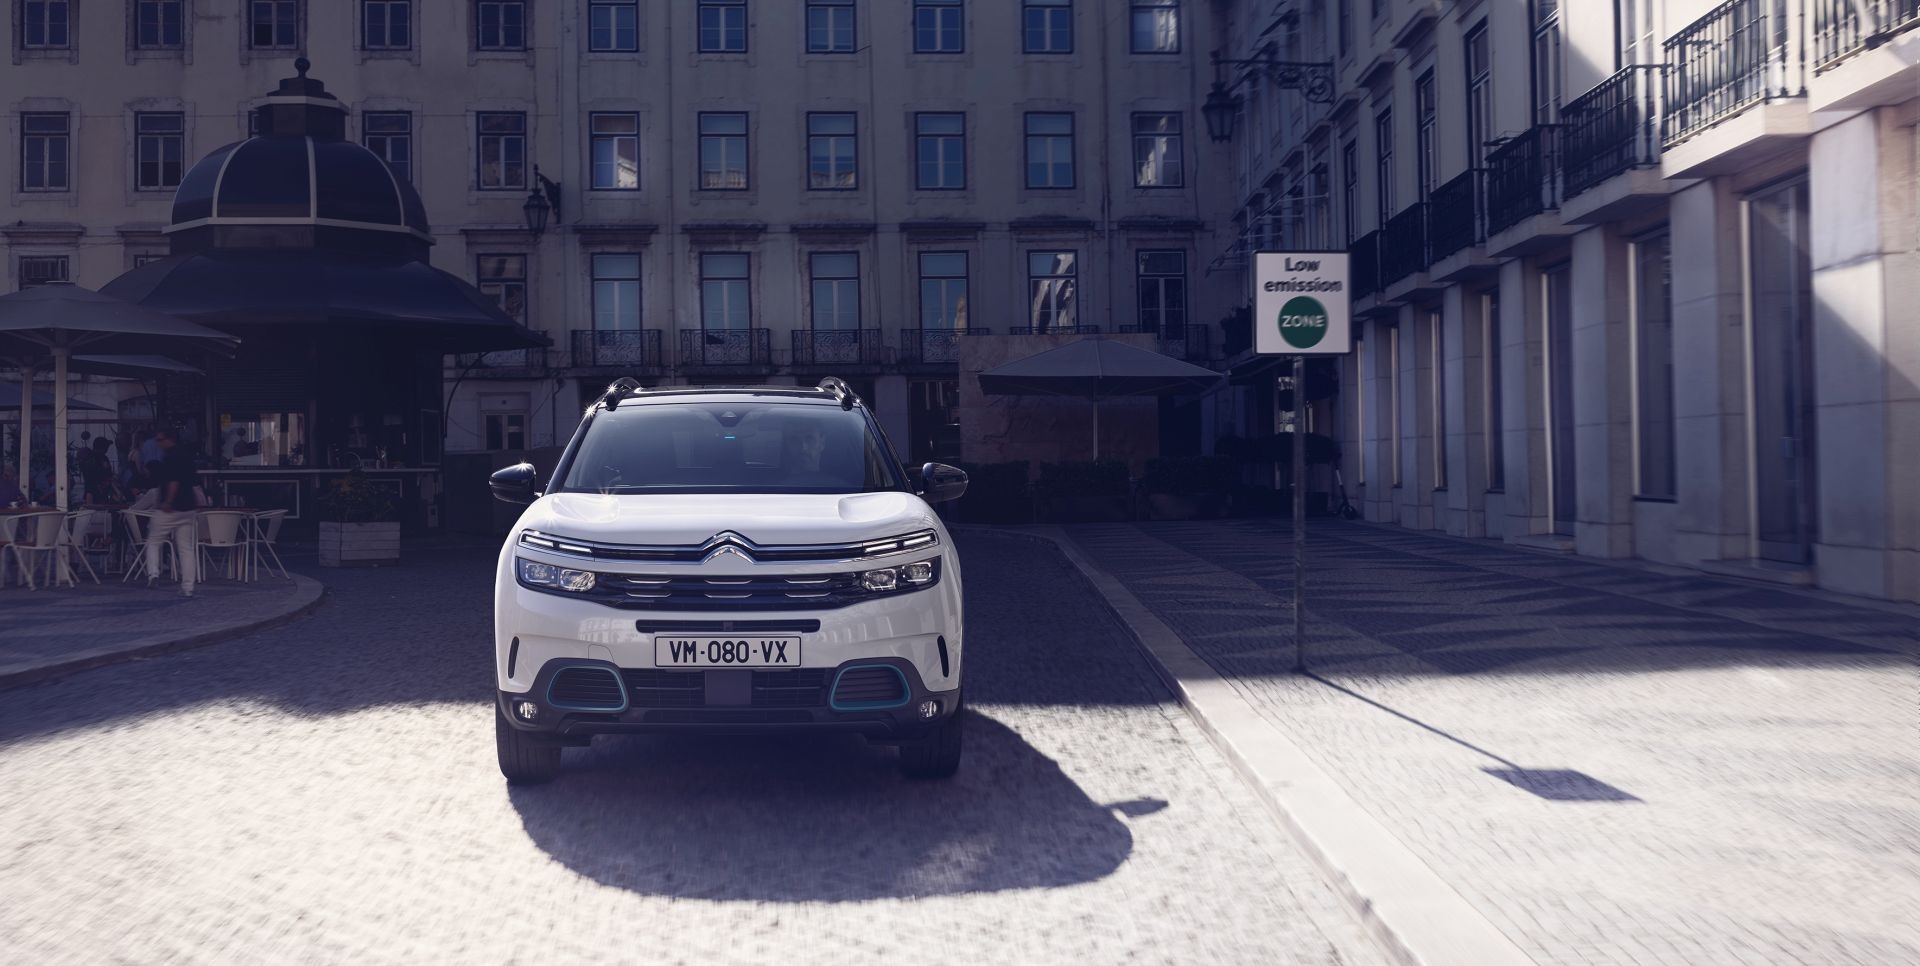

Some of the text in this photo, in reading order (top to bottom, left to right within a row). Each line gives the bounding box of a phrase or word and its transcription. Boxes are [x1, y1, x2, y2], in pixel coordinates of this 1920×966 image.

[1284, 257, 1321, 272] Low
[1264, 277, 1343, 292] emission
[1281, 315, 1326, 328] ZONE
